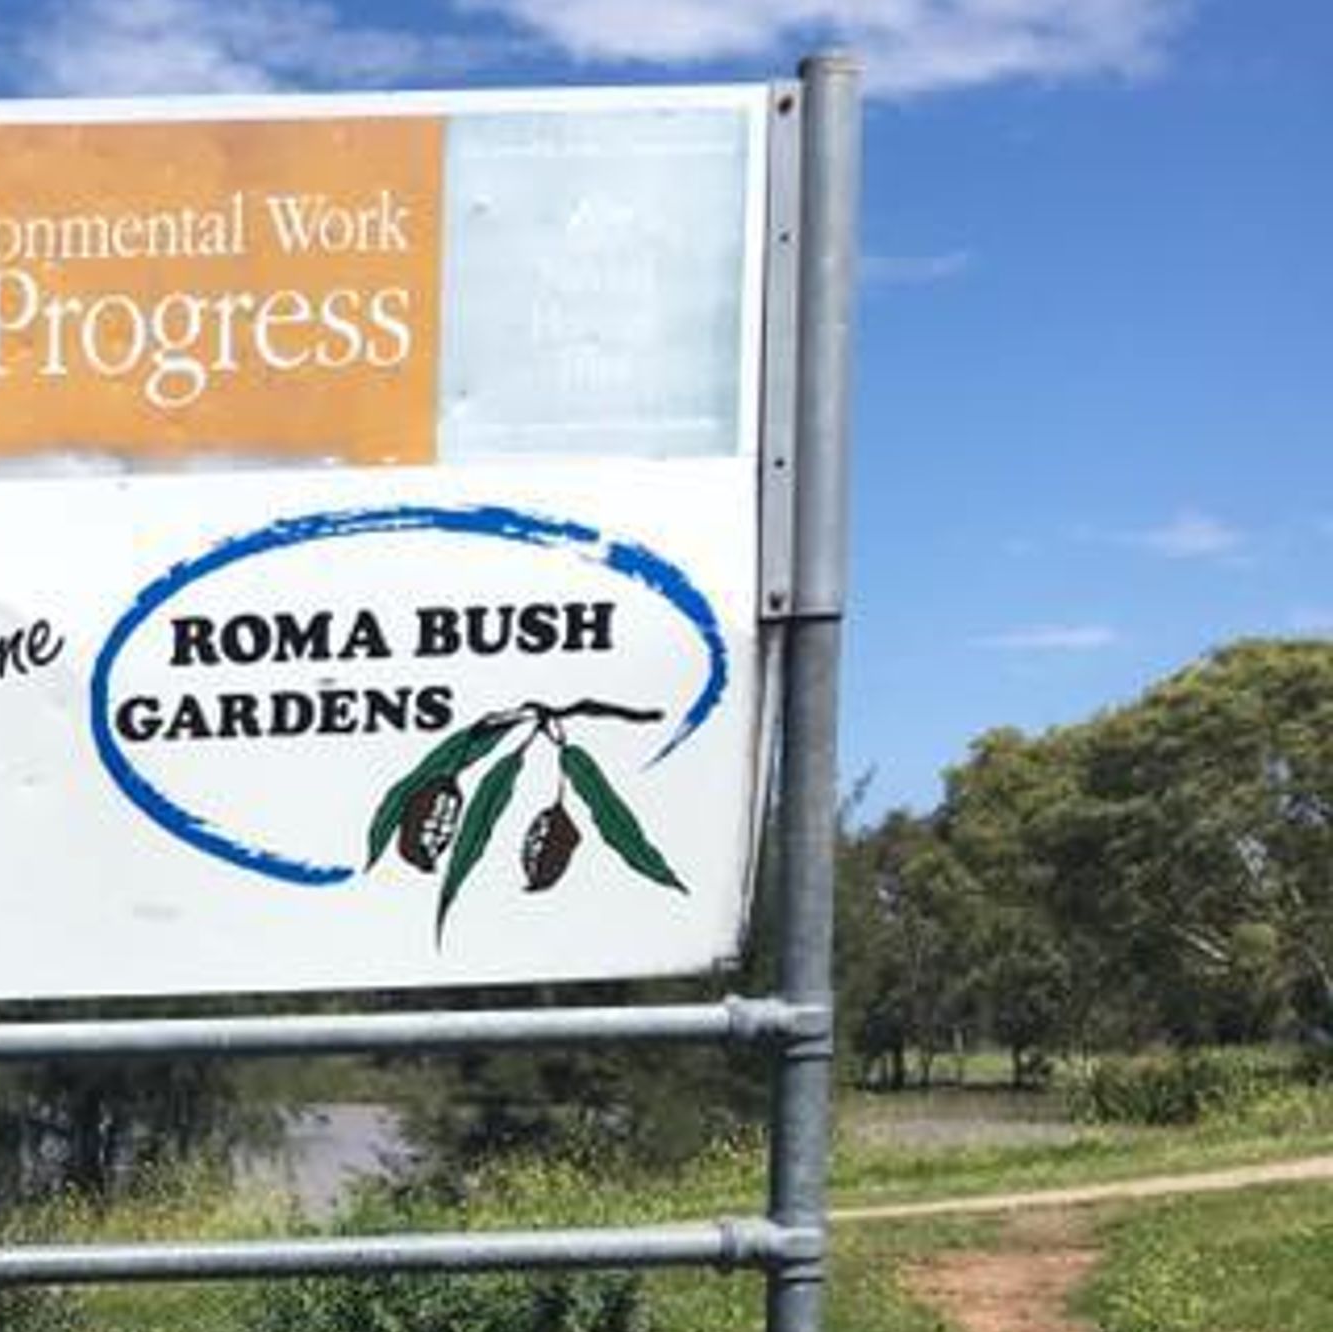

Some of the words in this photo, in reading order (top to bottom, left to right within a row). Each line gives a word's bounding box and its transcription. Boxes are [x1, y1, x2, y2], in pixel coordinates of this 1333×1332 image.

[267, 190, 410, 254] Work
[170, 610, 390, 666] ROMA
[414, 603, 616, 658] BUSH
[116, 687, 454, 742] GARDENS
